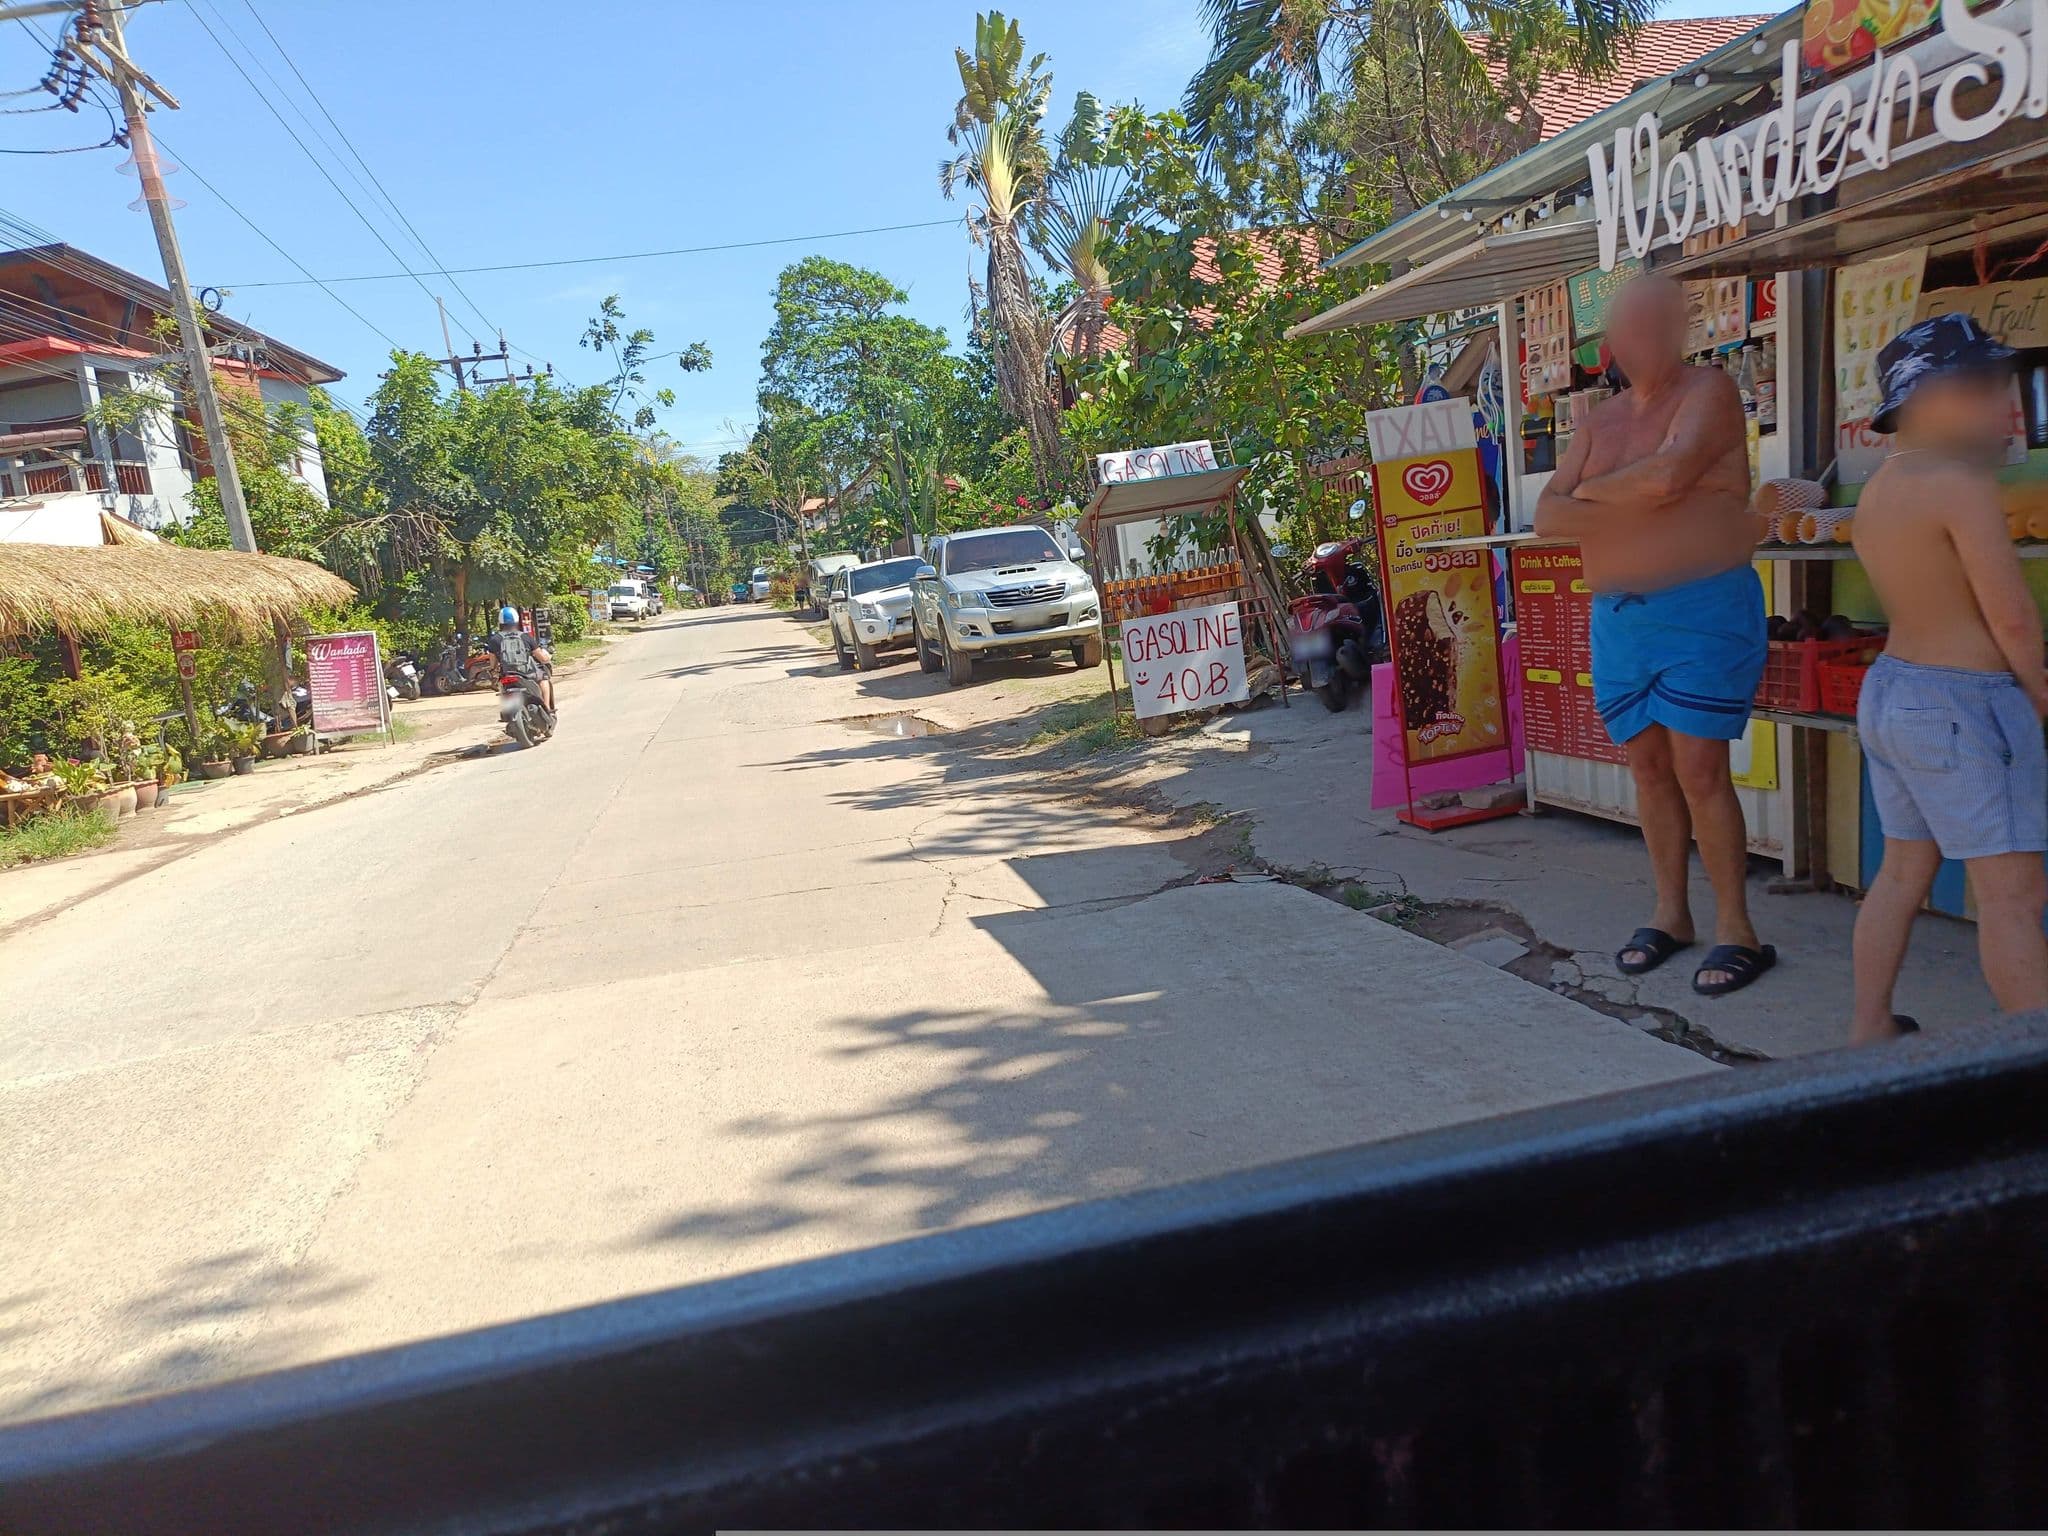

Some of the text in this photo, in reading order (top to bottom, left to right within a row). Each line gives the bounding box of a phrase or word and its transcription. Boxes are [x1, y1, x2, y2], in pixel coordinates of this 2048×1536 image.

[1987, 288, 2046, 334] Fruit
[1520, 555, 1582, 569] Drink & Coffee
[1127, 612, 1238, 663] GASOLINE
